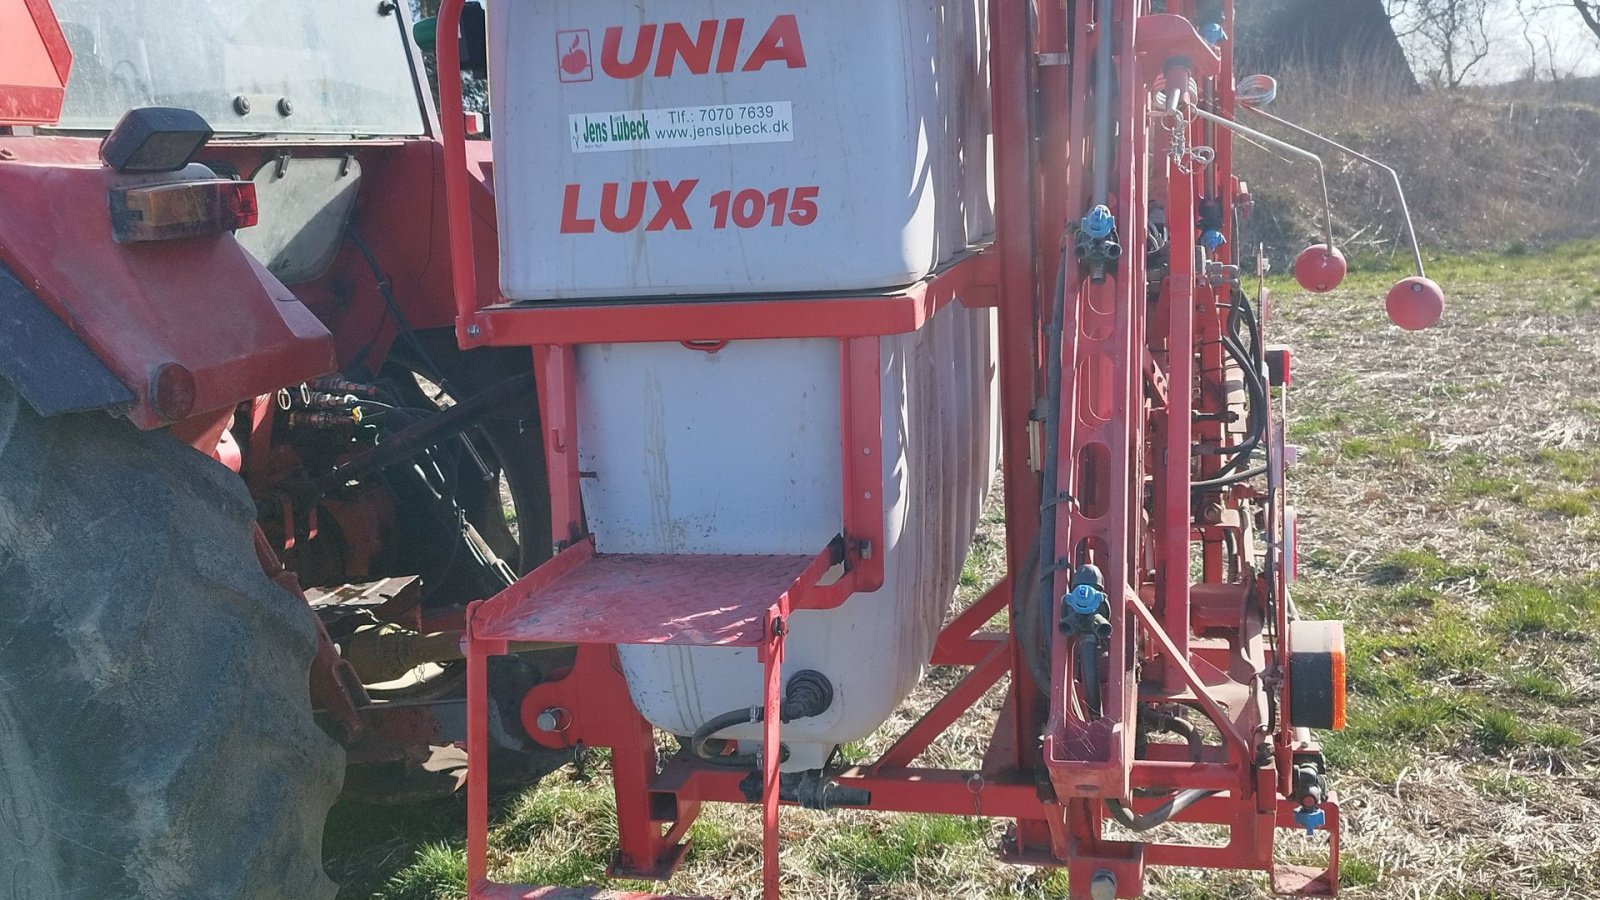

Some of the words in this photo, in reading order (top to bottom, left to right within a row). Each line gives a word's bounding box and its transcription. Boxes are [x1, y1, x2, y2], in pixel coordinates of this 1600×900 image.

[600, 14, 807, 79] UNIA
[668, 110, 694, 124] Tlf.:
[699, 107, 734, 122] 7070
[739, 105, 774, 119] 7639
[583, 115, 608, 143] Jens
[655, 119, 789, 140] www.jenslubeck.dk
[560, 179, 700, 234] LUX
[709, 186, 819, 229] 1015
